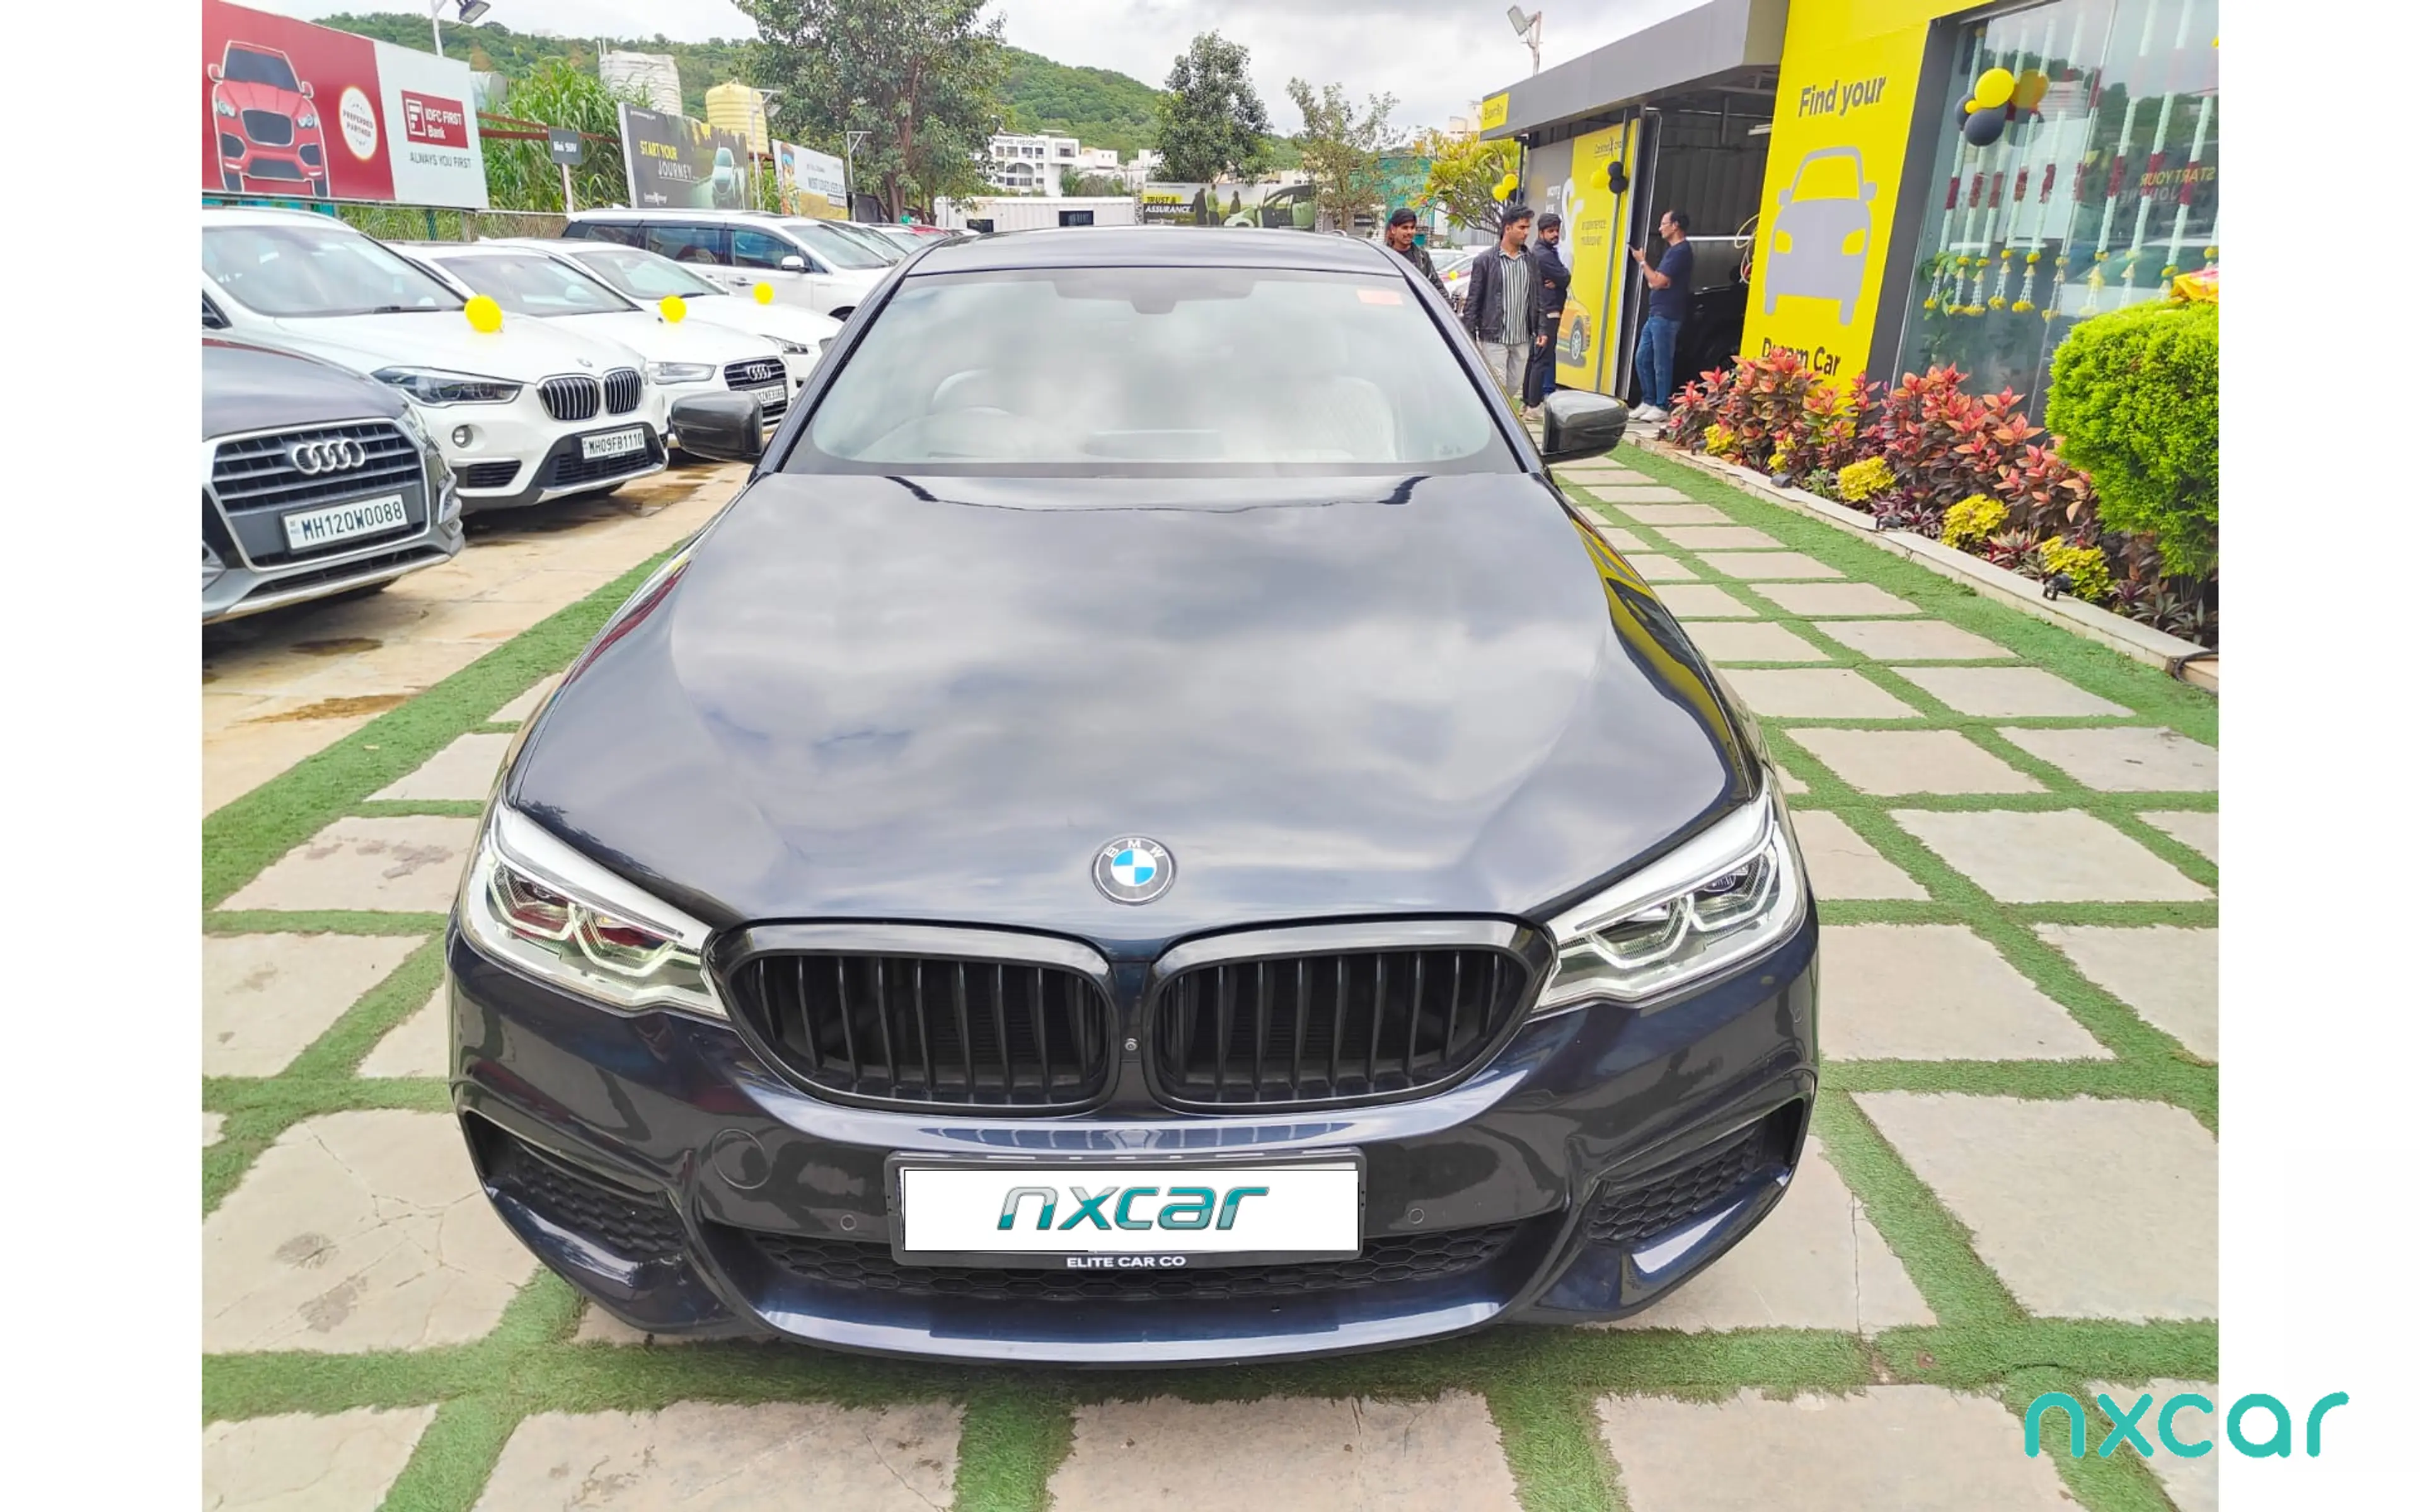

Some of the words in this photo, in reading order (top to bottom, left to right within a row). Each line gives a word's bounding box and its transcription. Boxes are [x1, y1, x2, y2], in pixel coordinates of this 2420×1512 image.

[1798, 79, 1839, 118] Find
[1839, 76, 1887, 116] your
[425, 107, 442, 123] IDFC
[442, 111, 462, 125] FIRST
[346, 121, 371, 137] PARTNER
[427, 125, 446, 139] Bank
[640, 140, 660, 158] START
[660, 144, 678, 161] YOUR
[410, 151, 438, 166] ALWAYS
[439, 155, 452, 167] YOU
[454, 157, 471, 169] FIRST
[1145, 205, 1191, 213] ASSURANCE
[1814, 346, 1841, 376] Car
[589, 432, 643, 454] MH09FB1110
[301, 501, 403, 541] MH12QW0088
[1104, 840, 1165, 858] BMW
[1067, 1256, 1114, 1268] ELITE
[1118, 1256, 1155, 1268] CAR
[1159, 1256, 1186, 1267] CO
